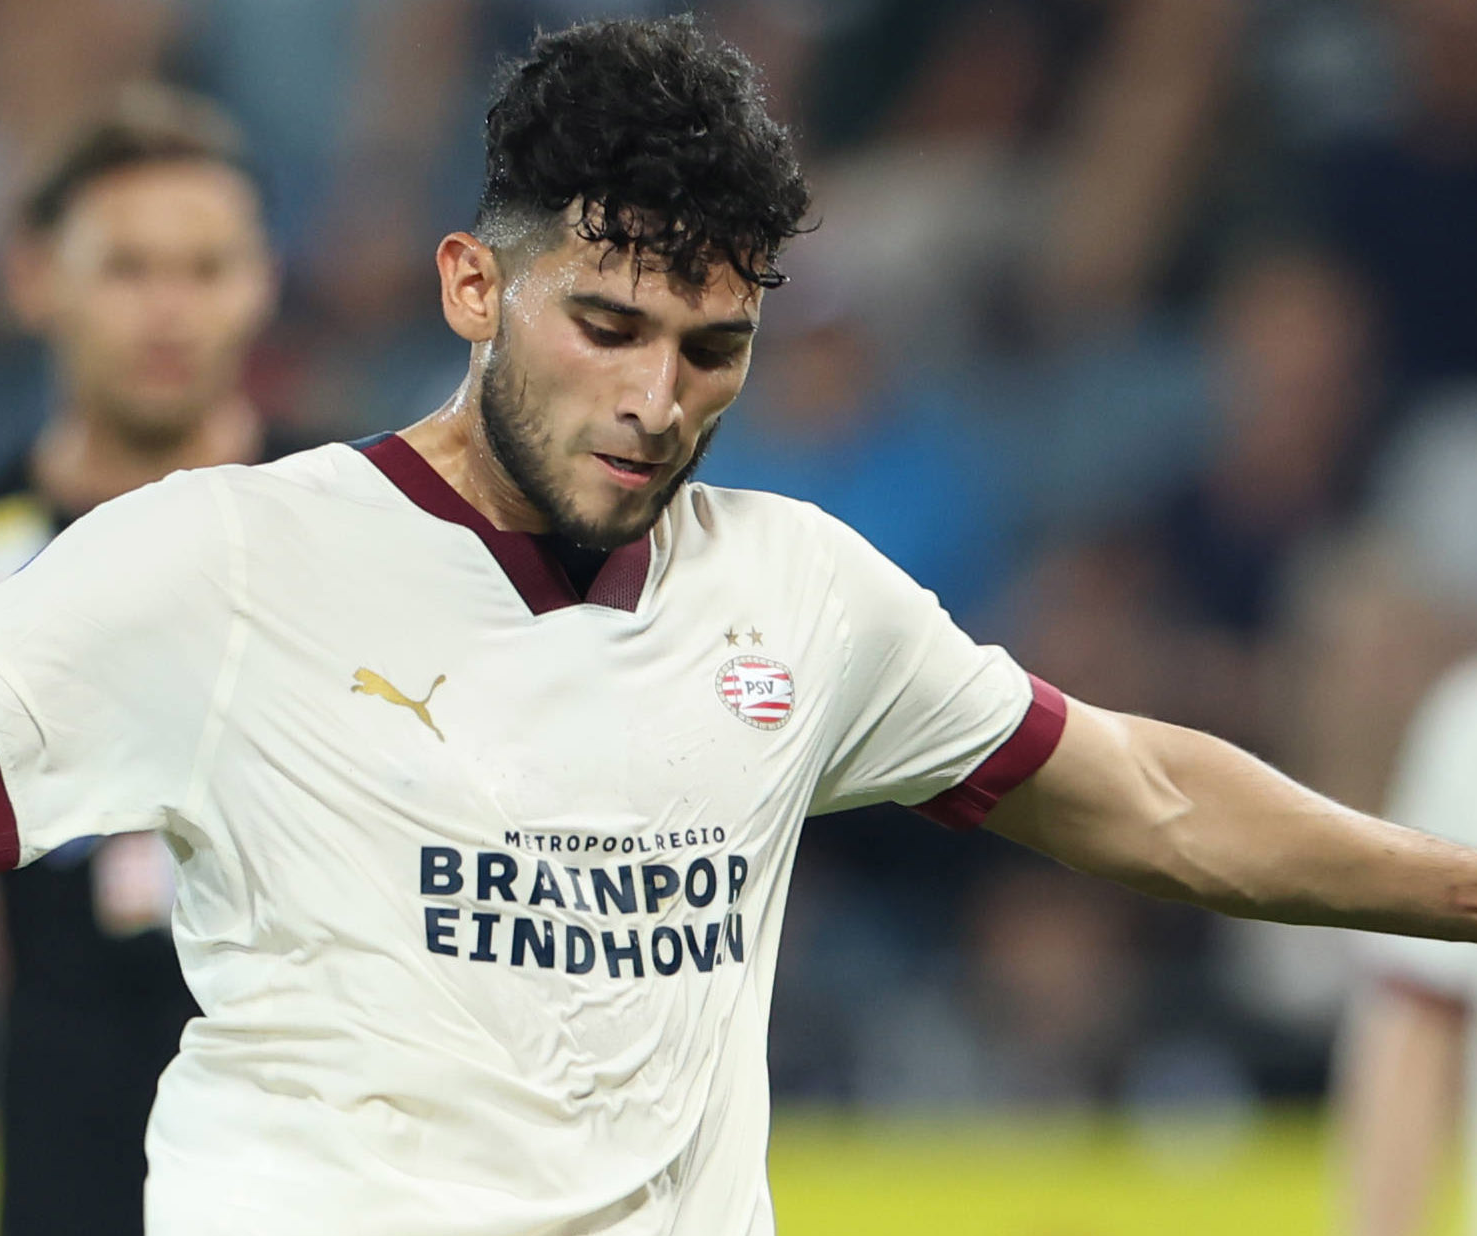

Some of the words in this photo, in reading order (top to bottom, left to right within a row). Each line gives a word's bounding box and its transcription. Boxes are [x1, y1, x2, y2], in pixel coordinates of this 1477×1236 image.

[745, 680, 775, 695] PSV
[504, 826, 725, 853] METROPOOLREGIO
[420, 846, 748, 914] BRAINPOR
[424, 908, 744, 978] EINDHOVN
